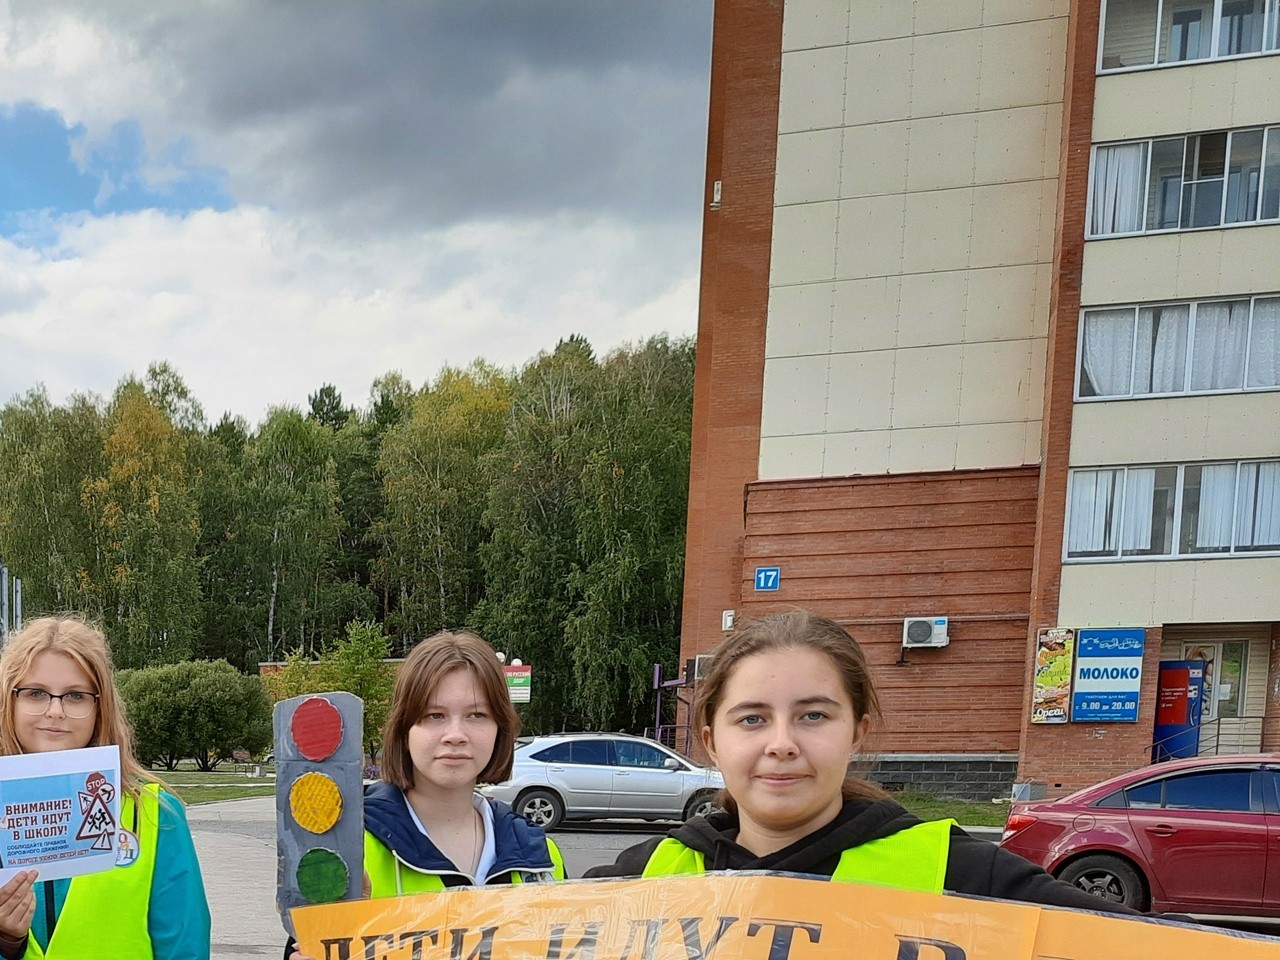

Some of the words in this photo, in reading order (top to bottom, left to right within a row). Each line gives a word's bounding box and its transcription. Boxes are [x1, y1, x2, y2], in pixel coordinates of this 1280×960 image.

[758, 571, 777, 588] 17
[1079, 667, 1139, 680] МОЛОКО
[1081, 701, 1100, 710] 9.00
[1111, 701, 1136, 710] 20.00
[87, 778, 104, 790] STOP
[5, 799, 72, 815] ВНИМАНИЕ!
[7, 816, 38, 829] ДЕТИ
[42, 812, 71, 825] ИДУТ
[13, 830, 20, 840] В
[25, 825, 67, 839] ШКОЛУ!
